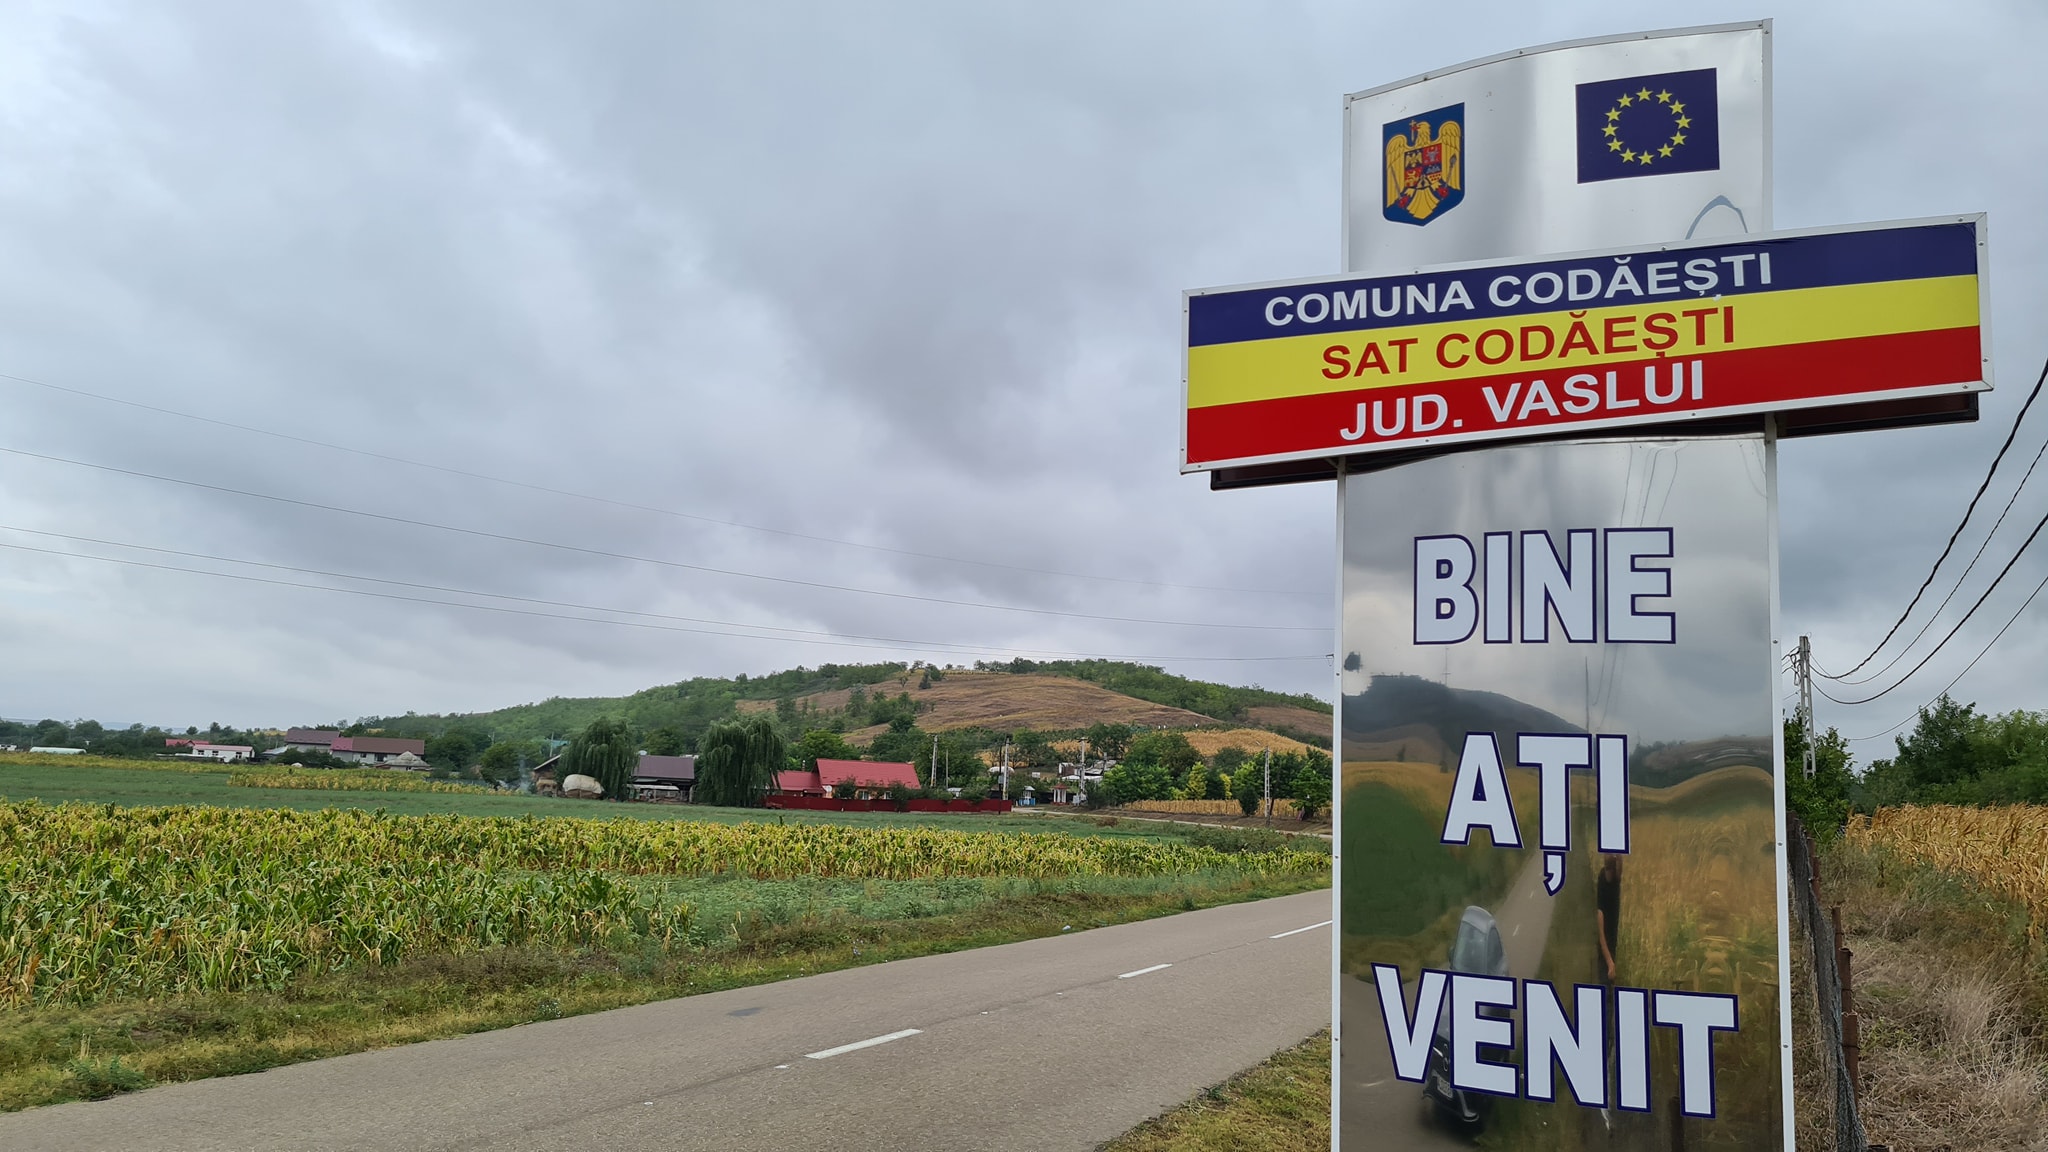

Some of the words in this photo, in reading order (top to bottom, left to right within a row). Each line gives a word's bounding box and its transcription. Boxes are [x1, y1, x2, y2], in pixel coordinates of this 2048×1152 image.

[1264, 281, 1475, 328] COMUNA
[1488, 252, 1772, 307] CODĂEȘTI
[1321, 337, 1418, 380] SAT
[1436, 307, 1736, 367] CODĂEȘTI
[1339, 392, 1464, 441] JUD.
[1482, 361, 1705, 422] VASLUI
[1414, 527, 1676, 645] BINE
[1440, 732, 1631, 896] AȚI
[1371, 963, 1739, 1119] VENIT
